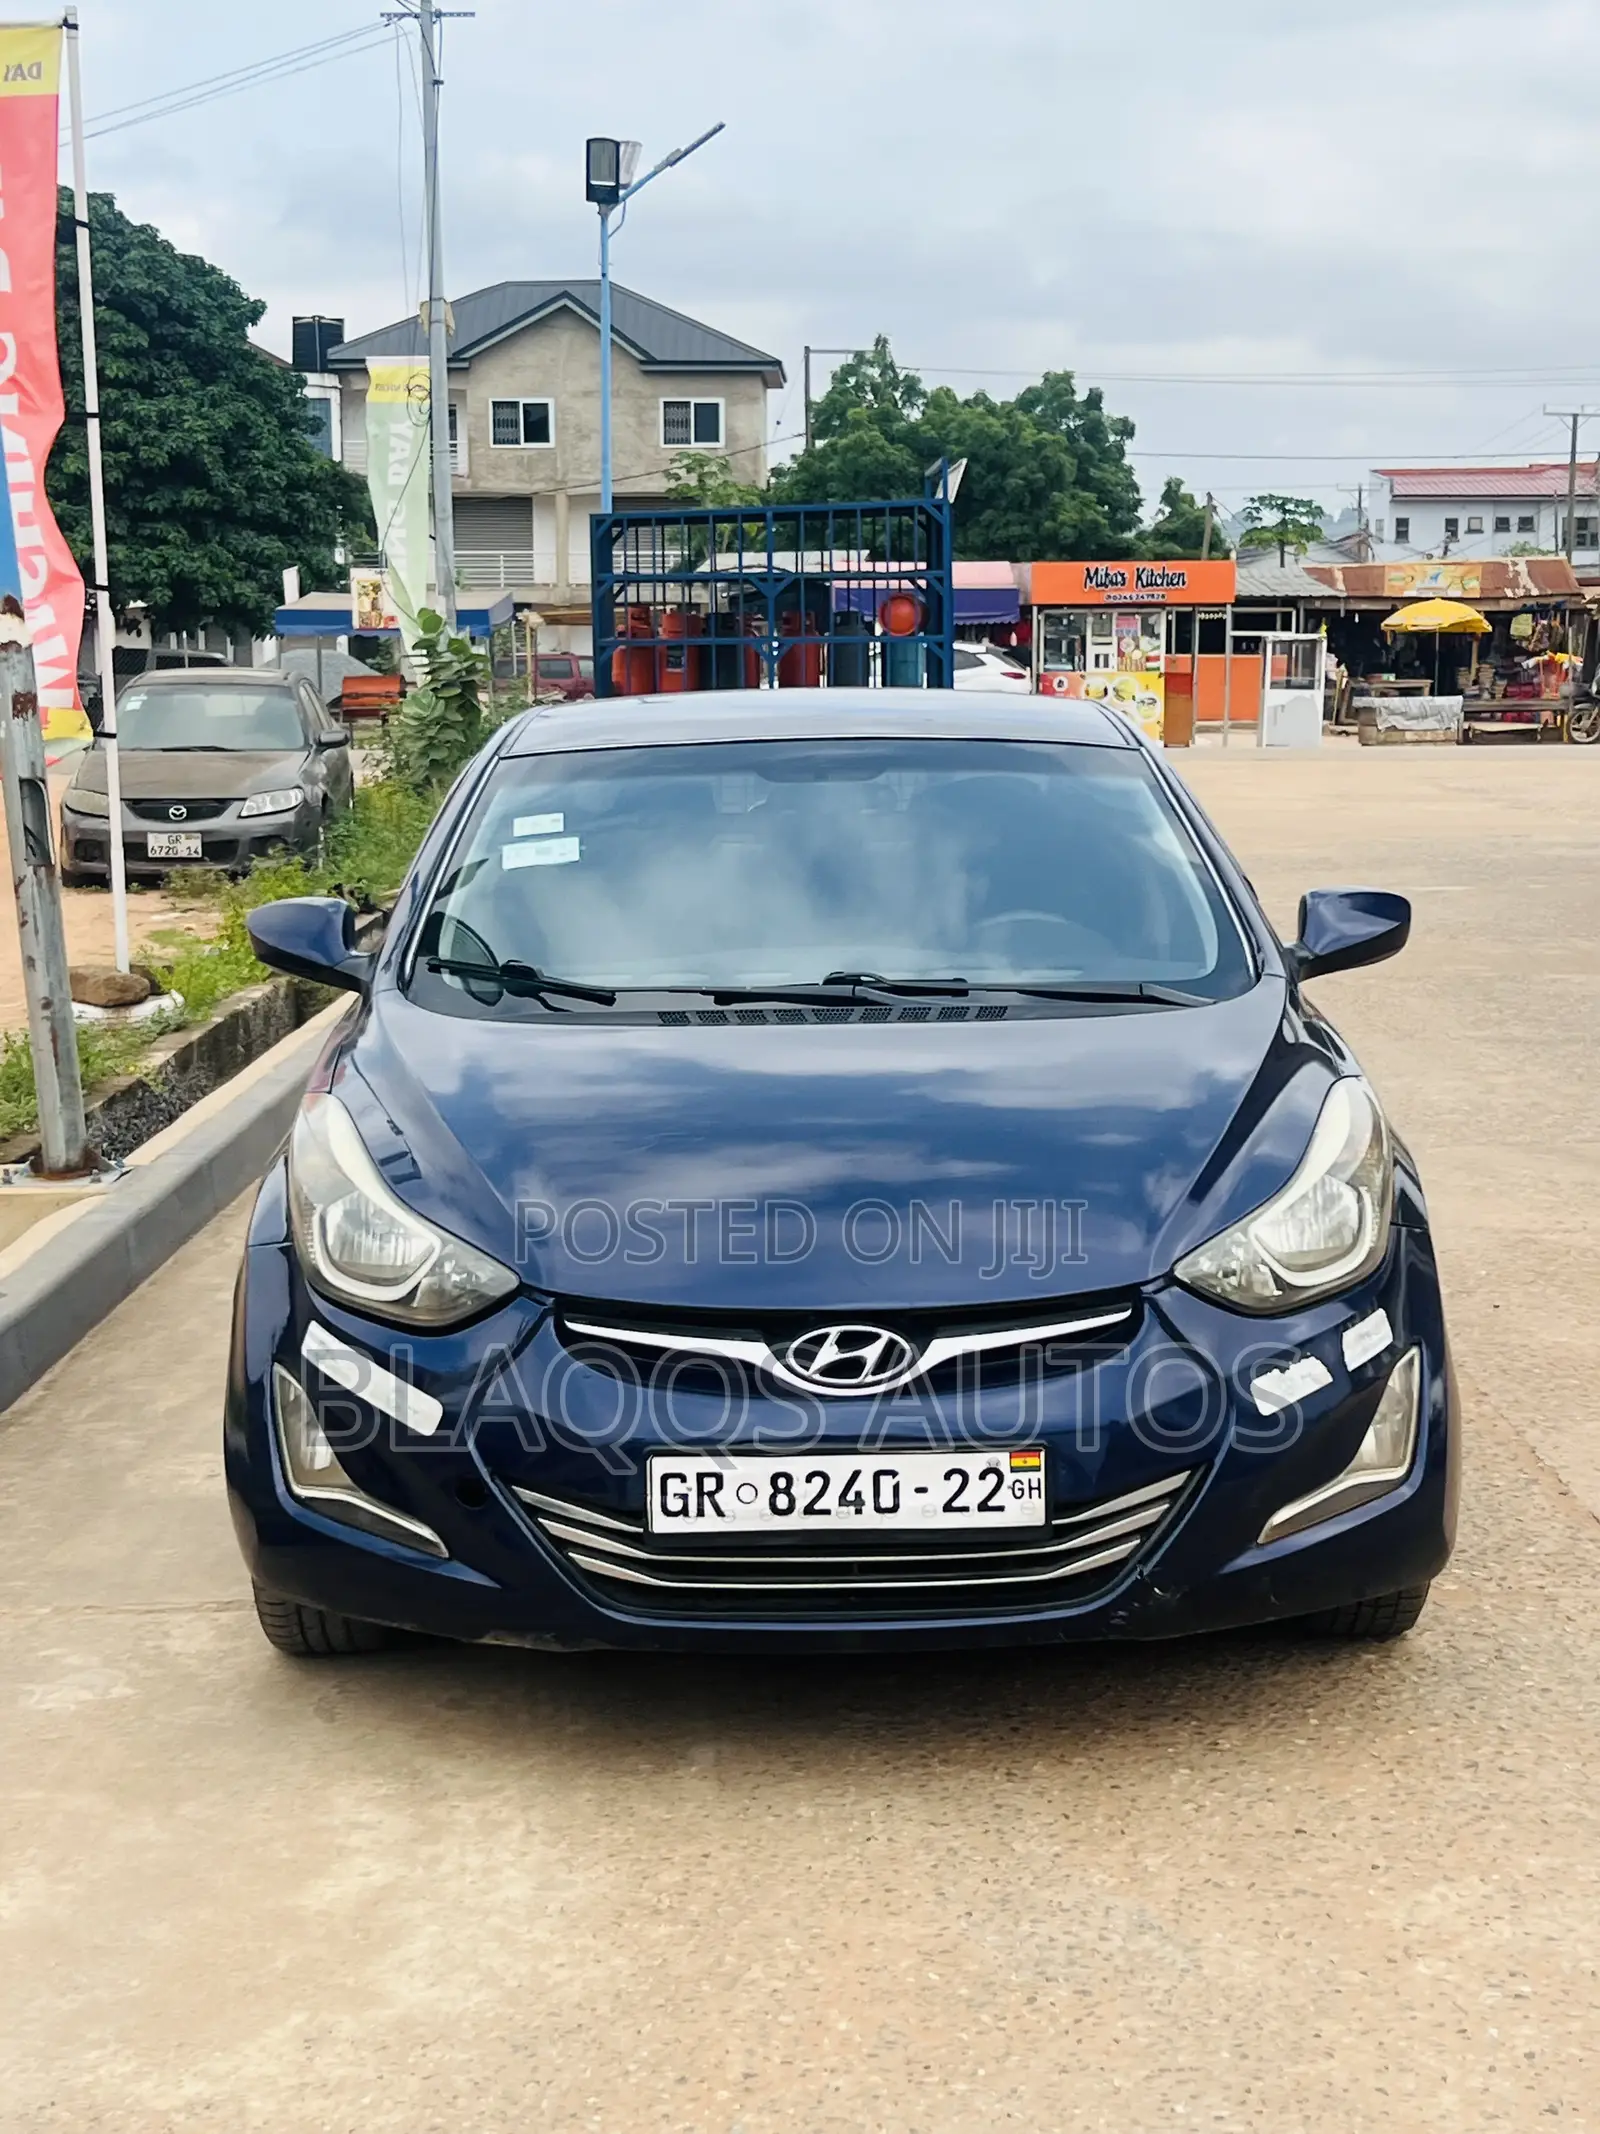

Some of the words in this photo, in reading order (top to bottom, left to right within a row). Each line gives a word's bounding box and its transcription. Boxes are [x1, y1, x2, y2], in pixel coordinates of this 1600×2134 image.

[1135, 566, 1186, 589] Kitchen
[167, 834, 182, 845] GR
[660, 1471, 726, 1518] GR
